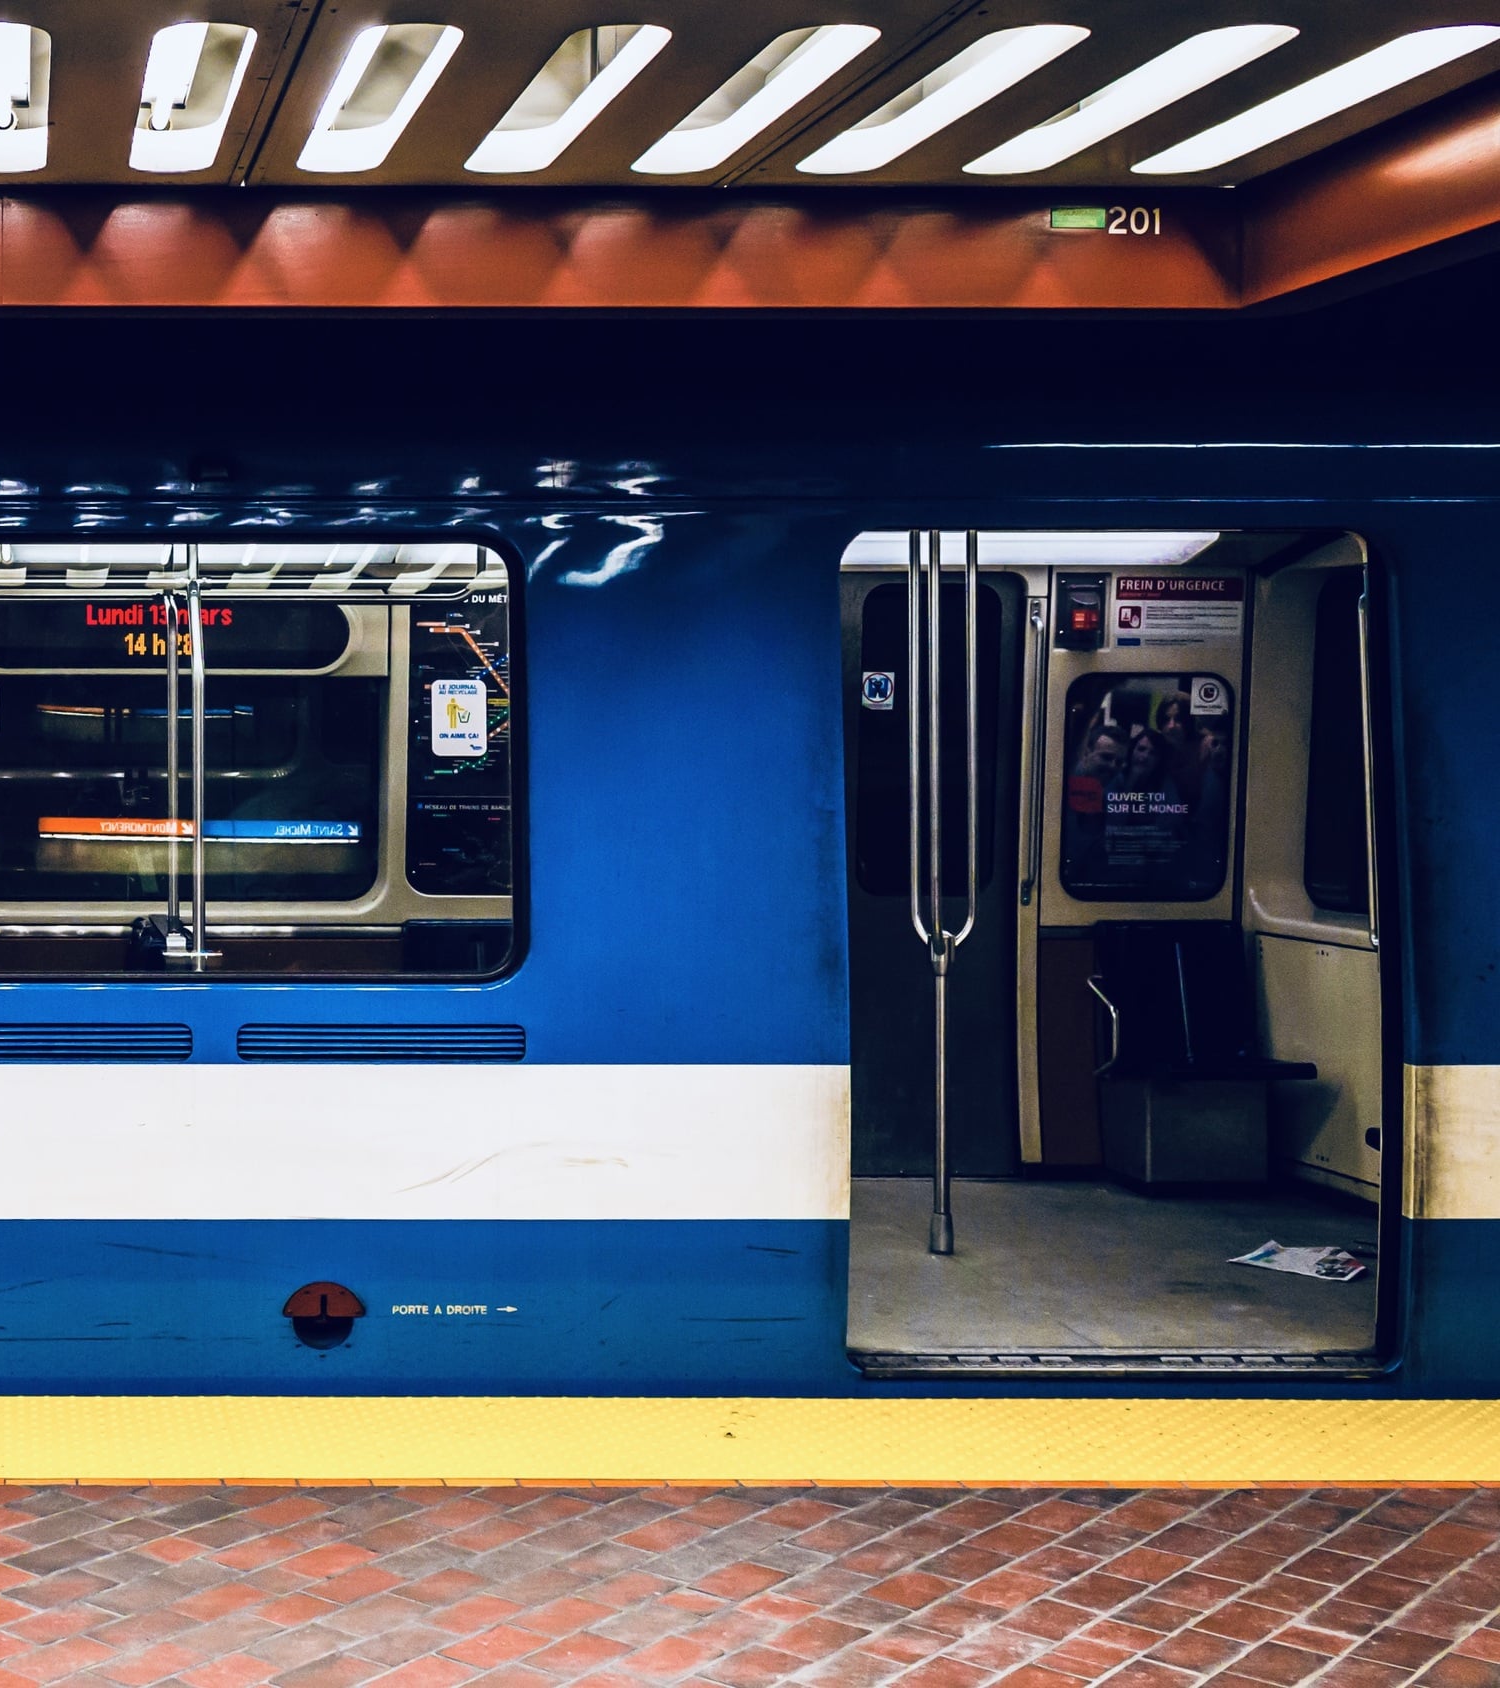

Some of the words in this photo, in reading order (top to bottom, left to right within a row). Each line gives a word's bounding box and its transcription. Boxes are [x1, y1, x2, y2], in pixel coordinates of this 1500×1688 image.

[1108, 206, 1160, 235] 201
[1119, 579, 1153, 591] FREIN
[1157, 579, 1226, 592] D'URGENCE
[471, 594, 486, 603] DU
[86, 604, 144, 626] Lundi
[150, 605, 168, 626] 13
[124, 632, 147, 656] 14
[152, 632, 166, 656] h
[1107, 792, 1166, 802] OUVRE-TOI
[1107, 804, 1130, 814] SUR
[1132, 804, 1146, 814] LE
[1148, 804, 1189, 814] MONDE
[392, 1304, 429, 1315] PORTE
[434, 1304, 443, 1315] A
[446, 1304, 488, 1315] DROITE
